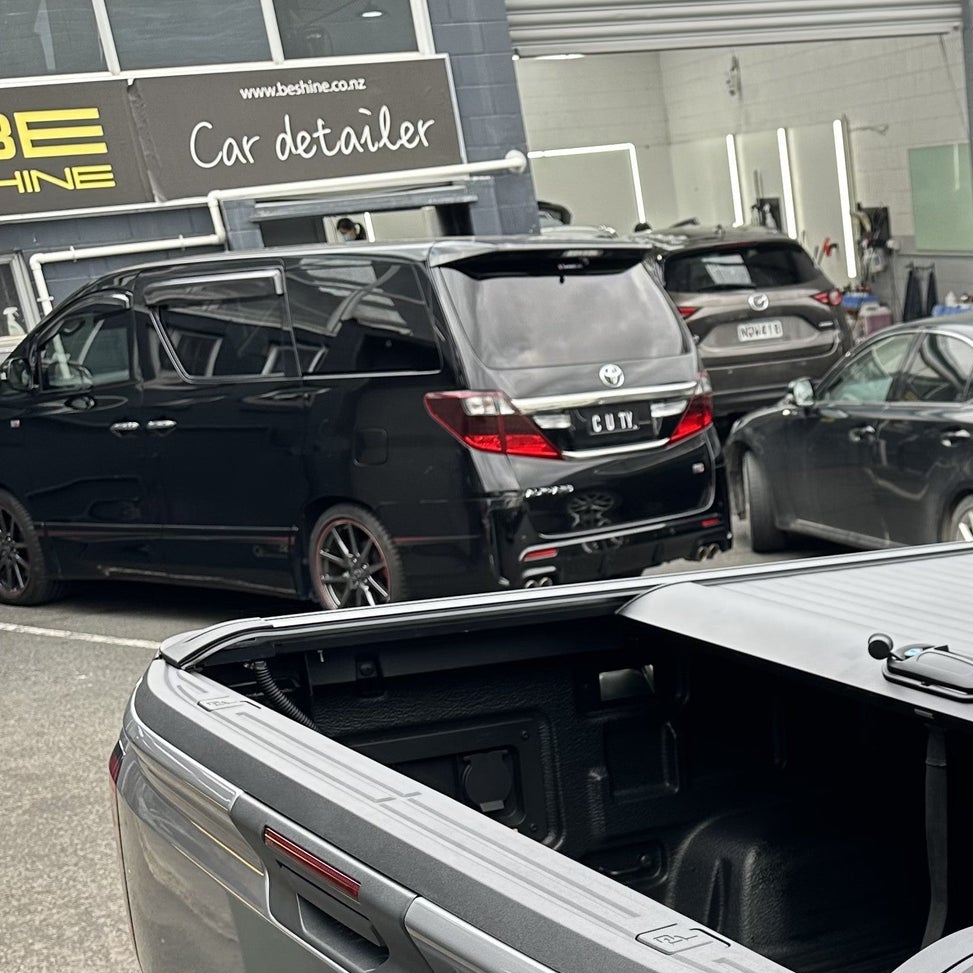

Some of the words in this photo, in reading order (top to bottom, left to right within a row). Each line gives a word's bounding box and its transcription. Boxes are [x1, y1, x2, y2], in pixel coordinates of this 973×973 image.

[239, 78, 367, 100] www.beshine.co.nz
[190, 121, 260, 169] Car
[275, 105, 435, 161] detailer
